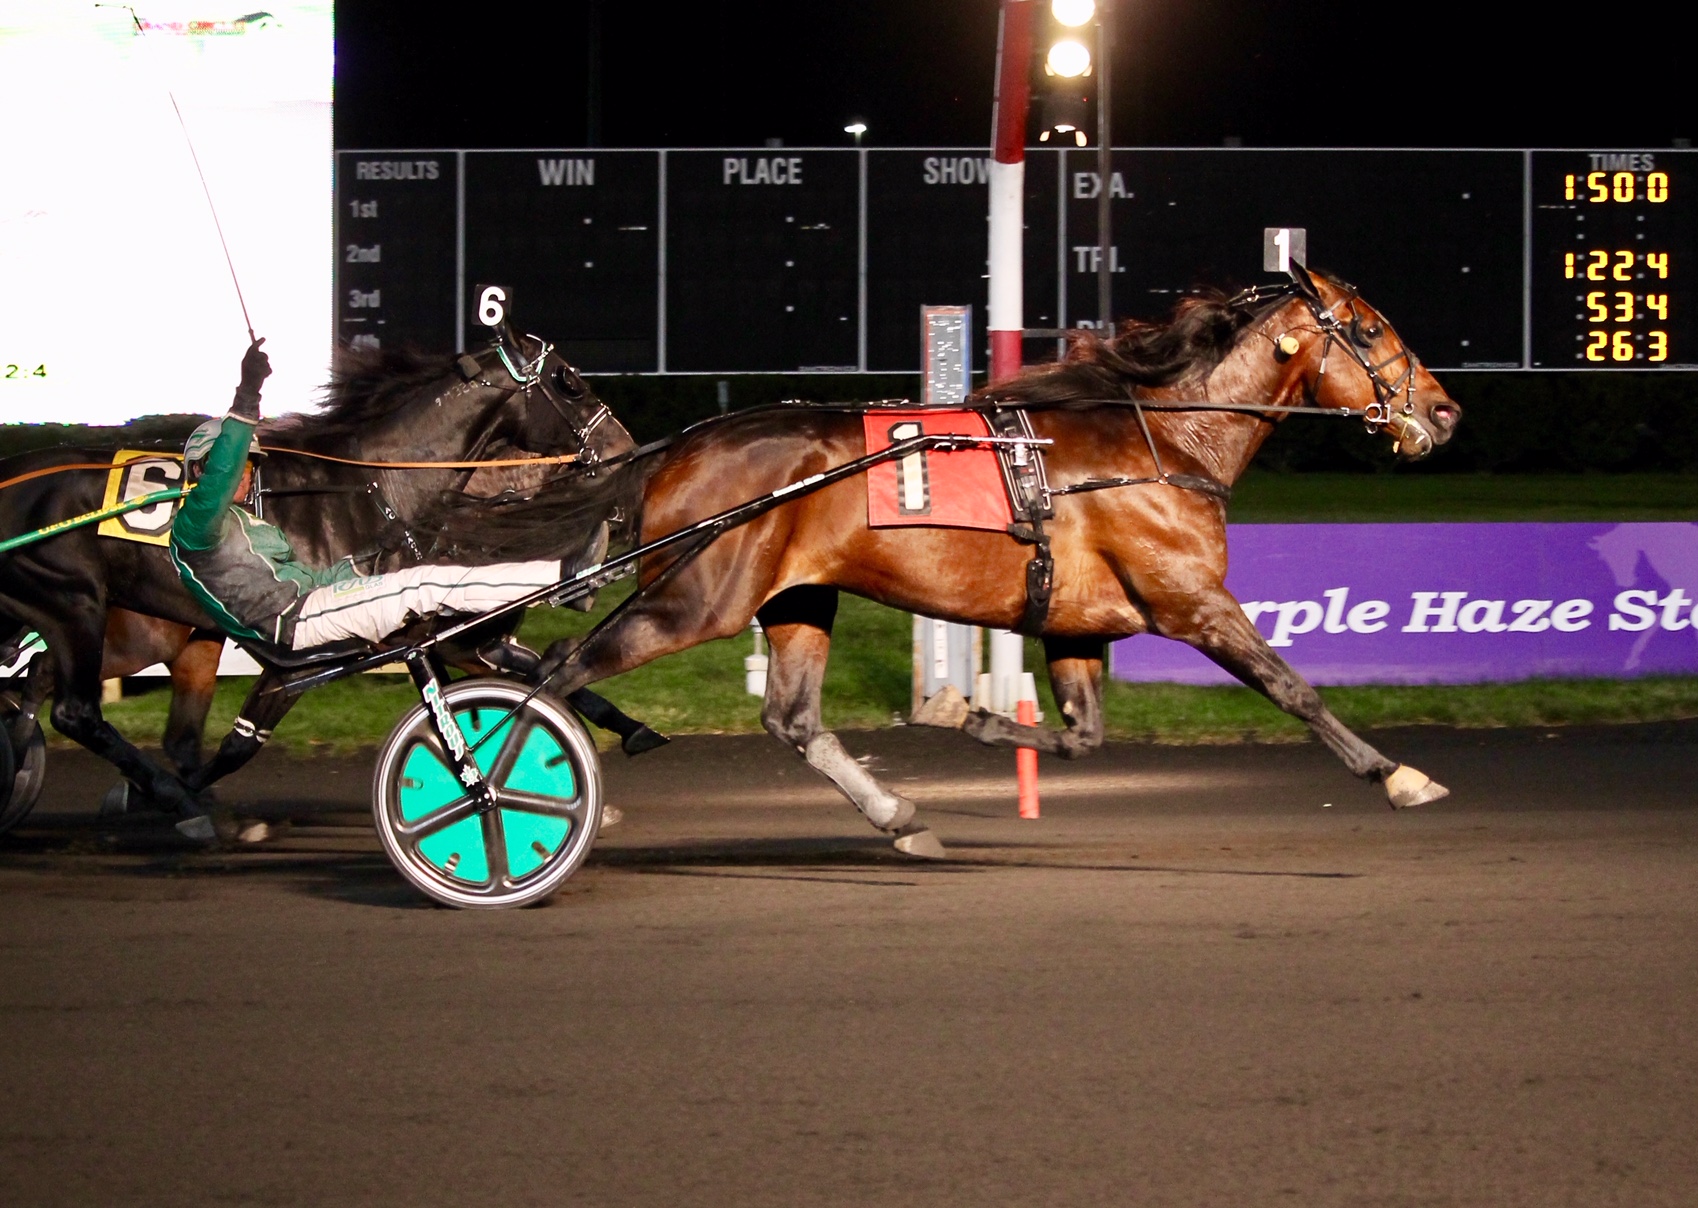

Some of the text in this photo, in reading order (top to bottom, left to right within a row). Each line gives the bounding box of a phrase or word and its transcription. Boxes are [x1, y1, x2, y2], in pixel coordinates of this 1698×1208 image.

[356, 161, 439, 180] RESULTS
[537, 159, 595, 186] WIN
[722, 157, 802, 185] PLACE
[1588, 153, 1655, 171] TIMES
[349, 200, 377, 218] 1st
[346, 244, 381, 263] 2nd
[1274, 228, 1289, 272] 1
[348, 288, 381, 308] 3rd
[478, 285, 506, 326] 6
[889, 422, 929, 513] 1
[119, 456, 184, 535] 6
[1401, 591, 1594, 633] Haze
[1608, 588, 1698, 632] St
[422, 677, 464, 762] NITROUS
